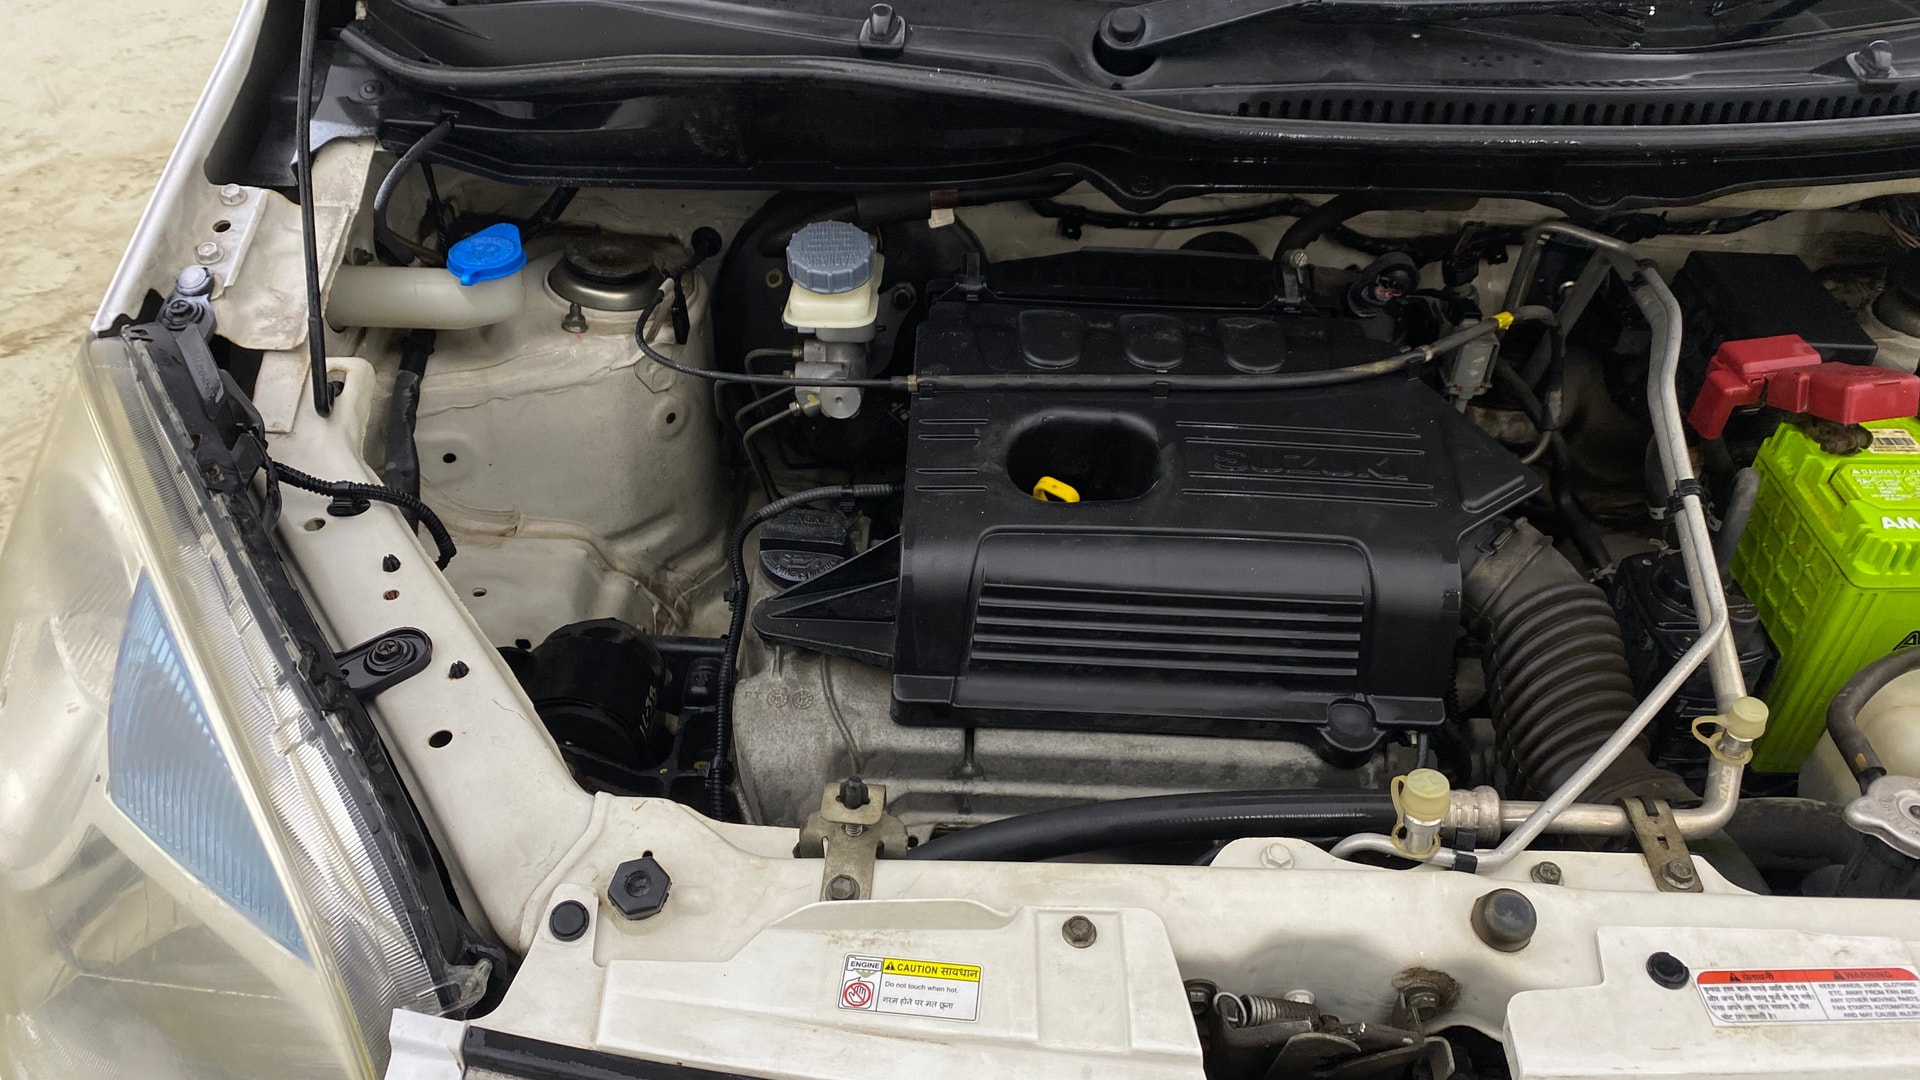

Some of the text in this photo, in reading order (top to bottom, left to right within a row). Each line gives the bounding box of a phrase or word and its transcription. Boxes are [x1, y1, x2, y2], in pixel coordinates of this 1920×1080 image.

[850, 961, 880, 969] ENGINE
[897, 963, 978, 979] CAUTION सावधान
[1844, 971, 1893, 979] WARNING
[883, 996, 899, 1004] गरम
[900, 997, 913, 1006] होने
